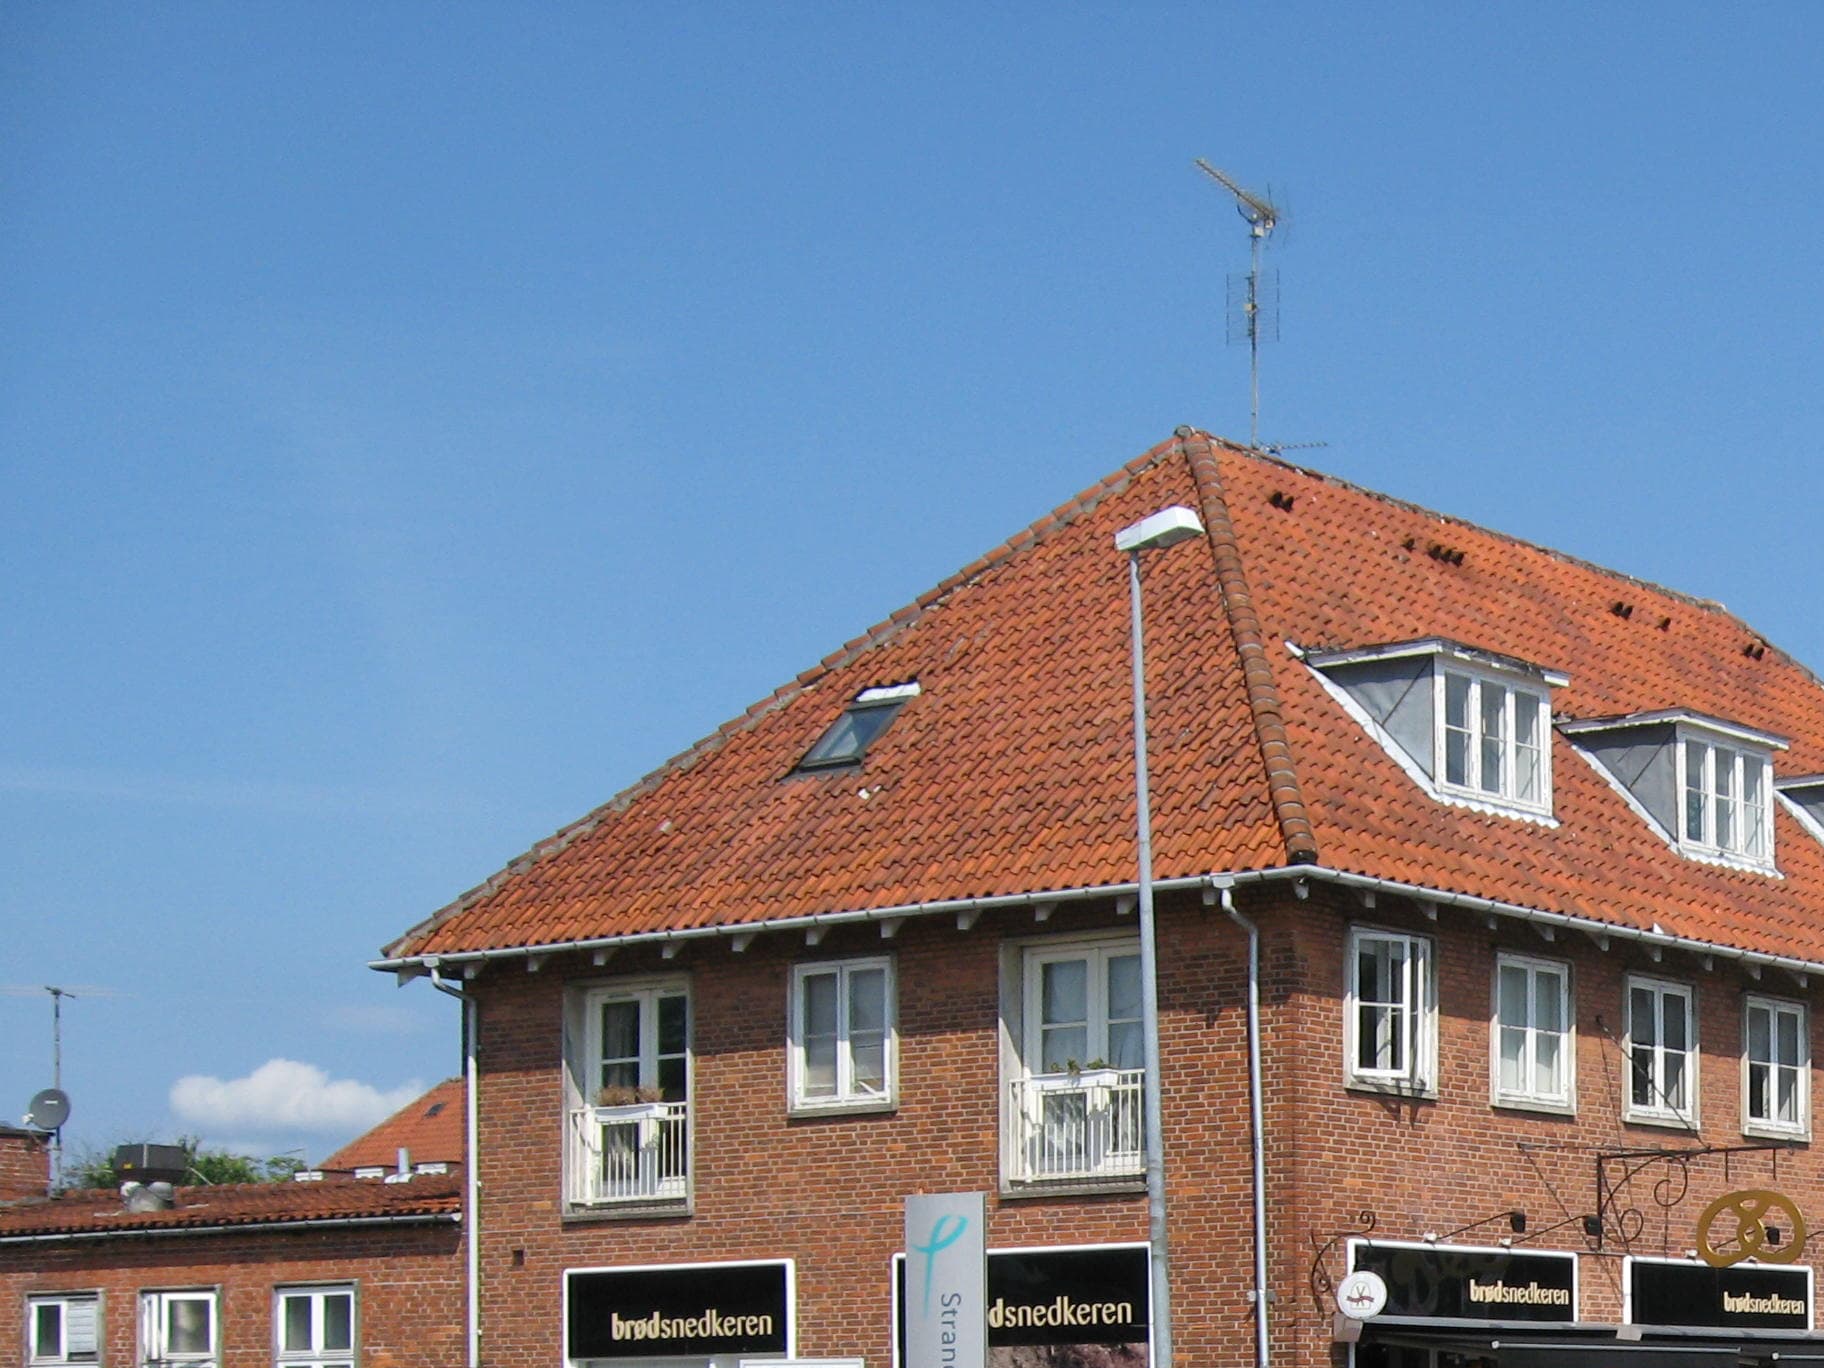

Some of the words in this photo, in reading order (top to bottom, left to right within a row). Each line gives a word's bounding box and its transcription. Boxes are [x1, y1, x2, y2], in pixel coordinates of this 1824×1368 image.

[1469, 1278, 1569, 1305] brødsnedkeren
[1723, 1291, 1805, 1315] brødsnedkeren
[611, 1308, 773, 1341] brødsnedkeren
[988, 1296, 1132, 1328] dsnedkeren
